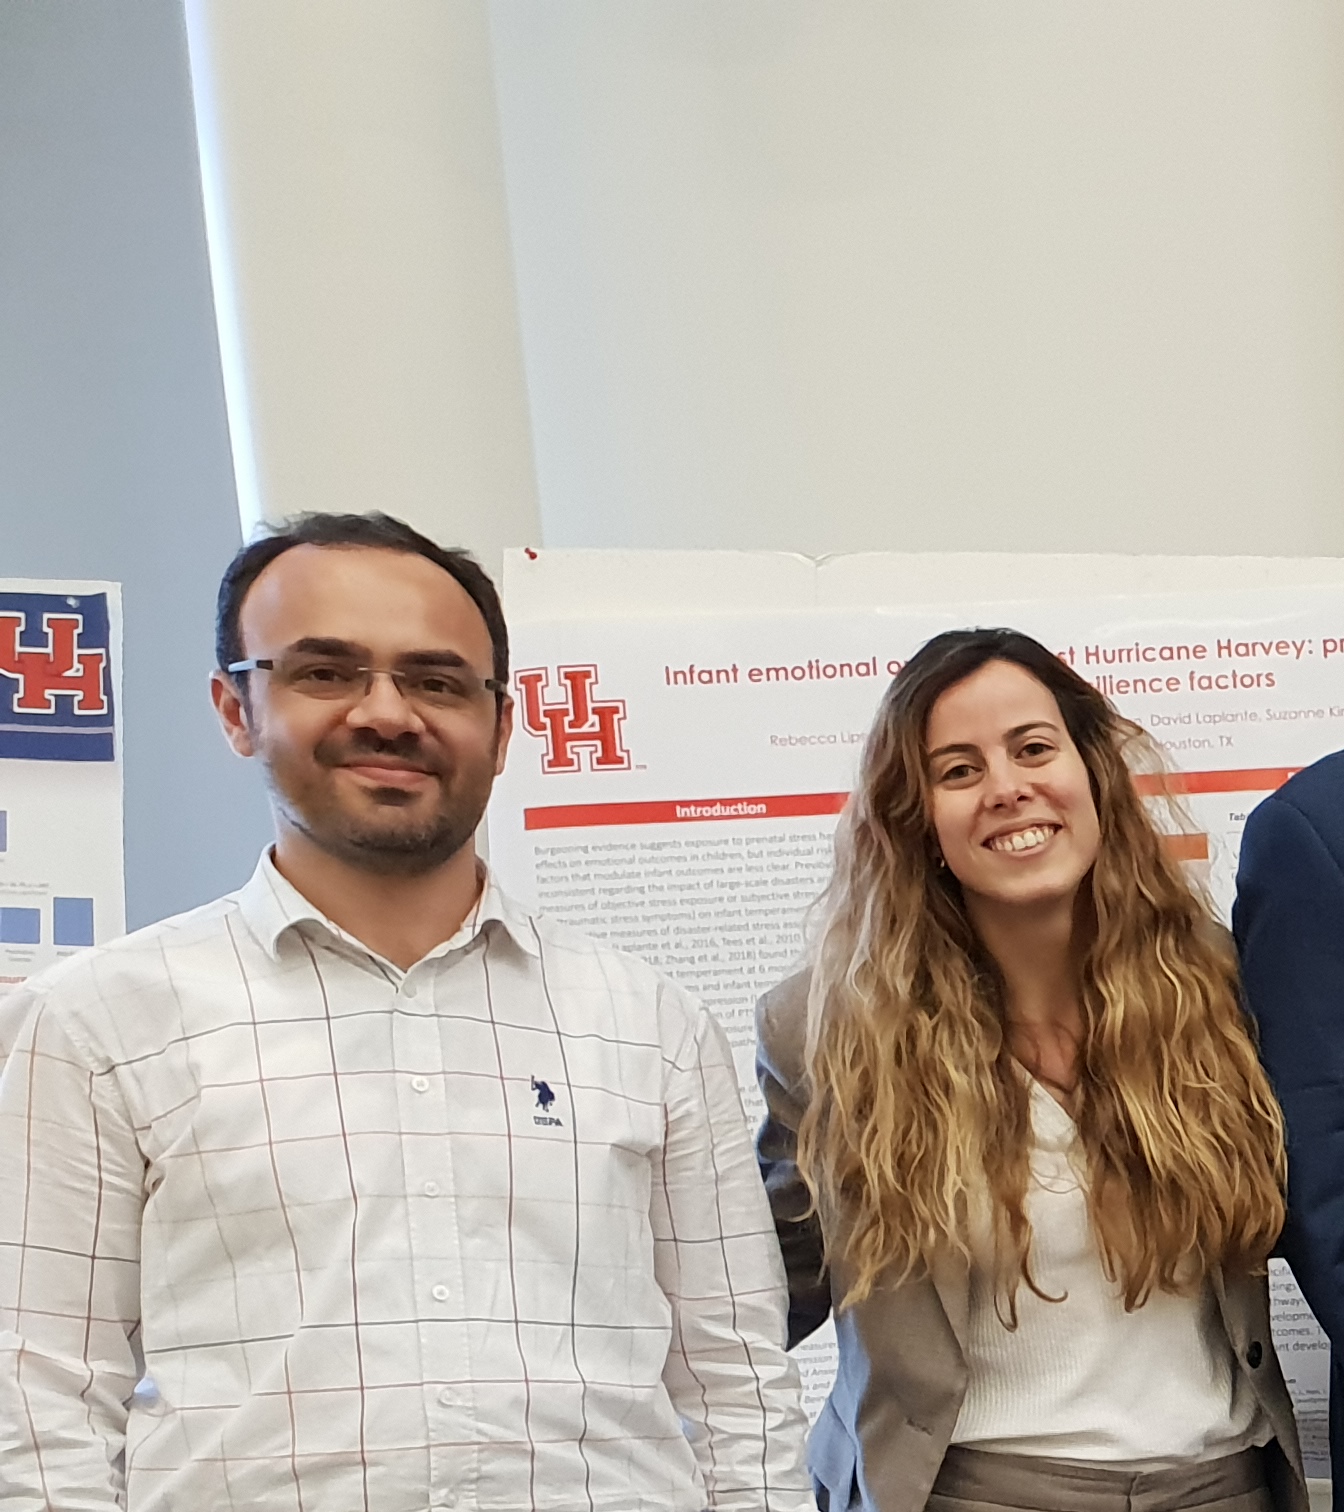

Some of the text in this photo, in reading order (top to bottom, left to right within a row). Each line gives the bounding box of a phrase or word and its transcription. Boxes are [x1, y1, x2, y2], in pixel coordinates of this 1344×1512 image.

[665, 663, 739, 685] Infant
[748, 656, 878, 683] emotional
[1085, 642, 1207, 665] Hurricane
[1217, 637, 1313, 660] Harvey:
[1189, 669, 1276, 693] factors
[1150, 711, 1193, 727] David
[1265, 706, 1324, 721] Suzanne
[770, 732, 836, 747] Rebecca
[1218, 736, 1234, 747] TX
[676, 803, 766, 818] Introduction
